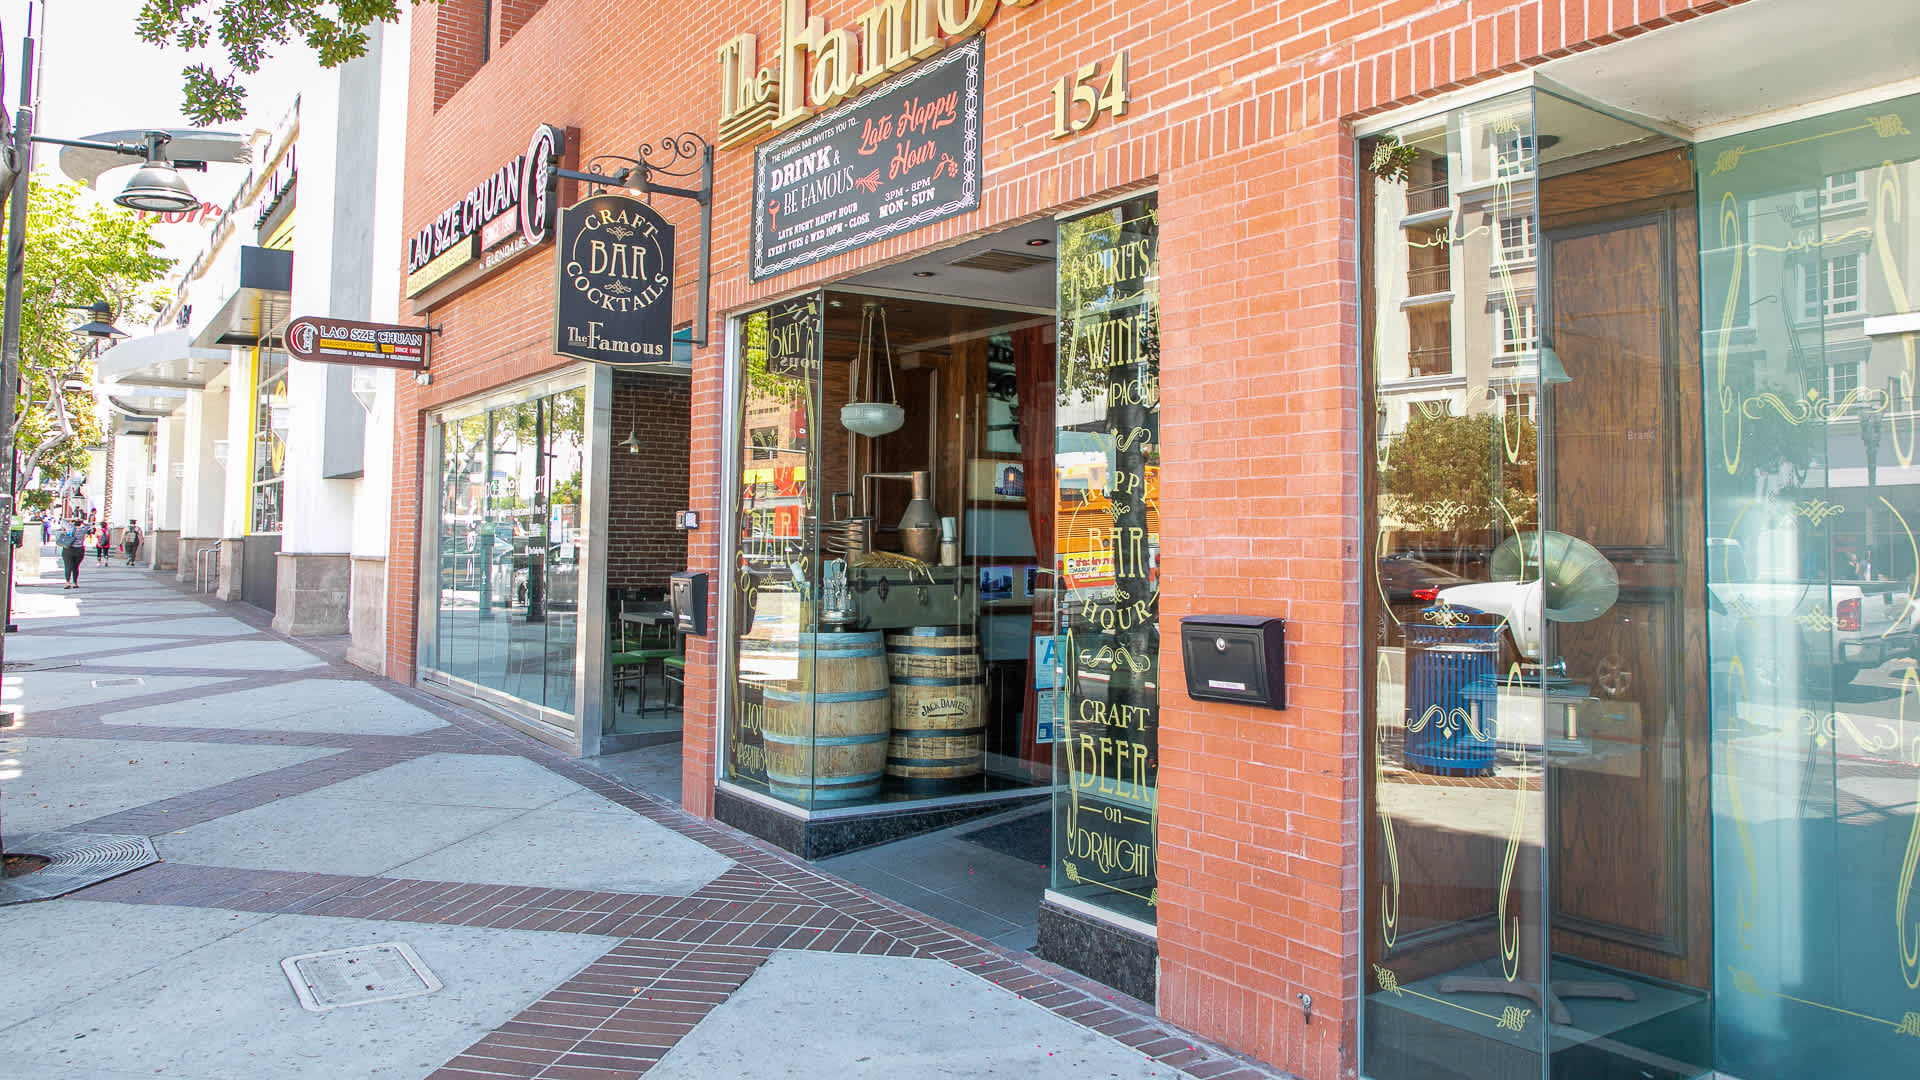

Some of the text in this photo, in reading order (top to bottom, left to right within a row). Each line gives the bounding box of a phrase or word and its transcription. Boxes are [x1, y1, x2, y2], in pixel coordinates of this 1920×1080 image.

[719, 0, 1037, 127] The Fam
[1050, 51, 1128, 141] 154
[771, 154, 783, 164] THE
[782, 145, 801, 161] FAMOUS
[802, 139, 813, 150] BAR
[812, 128, 835, 147] INVITES
[835, 123, 848, 135] YOU
[857, 90, 959, 156] Late Happy
[770, 145, 841, 192] DRINK &
[888, 140, 937, 181] Hour
[784, 165, 854, 217] BE FAMOUS
[885, 186, 904, 202] 3PM
[911, 176, 932, 192] 8PM
[911, 187, 936, 208] SUN
[407, 224, 433, 275] LAO
[434, 200, 462, 256] SZE
[462, 155, 521, 236] CHUAN
[584, 208, 659, 239] CRAFT
[767, 243, 786, 258] EVERY
[788, 238, 805, 250] TUES
[810, 229, 825, 243] WED
[826, 222, 843, 238] 10PM
[849, 212, 871, 228] CLOSE
[777, 202, 858, 241] LATE NIGHT HAPPY HOUR
[589, 239, 648, 281] BAR
[1083, 238, 1150, 290] SPIRITS
[566, 261, 669, 313] COCKTAILS
[320, 325, 348, 340] LAO
[350, 327, 376, 342] SZE
[377, 331, 423, 346] CHUAN
[567, 320, 664, 357] The Famous
[1085, 314, 1148, 370] WINE
[1080, 470, 1156, 507] HAPPY
[1087, 527, 1146, 579] BAR
[1080, 599, 1152, 630] HOUR
[1079, 698, 1150, 732] CRAFT
[1079, 733, 1150, 802] BEER
[1104, 806, 1122, 825] on
[1077, 827, 1151, 878] DRAUGHT
